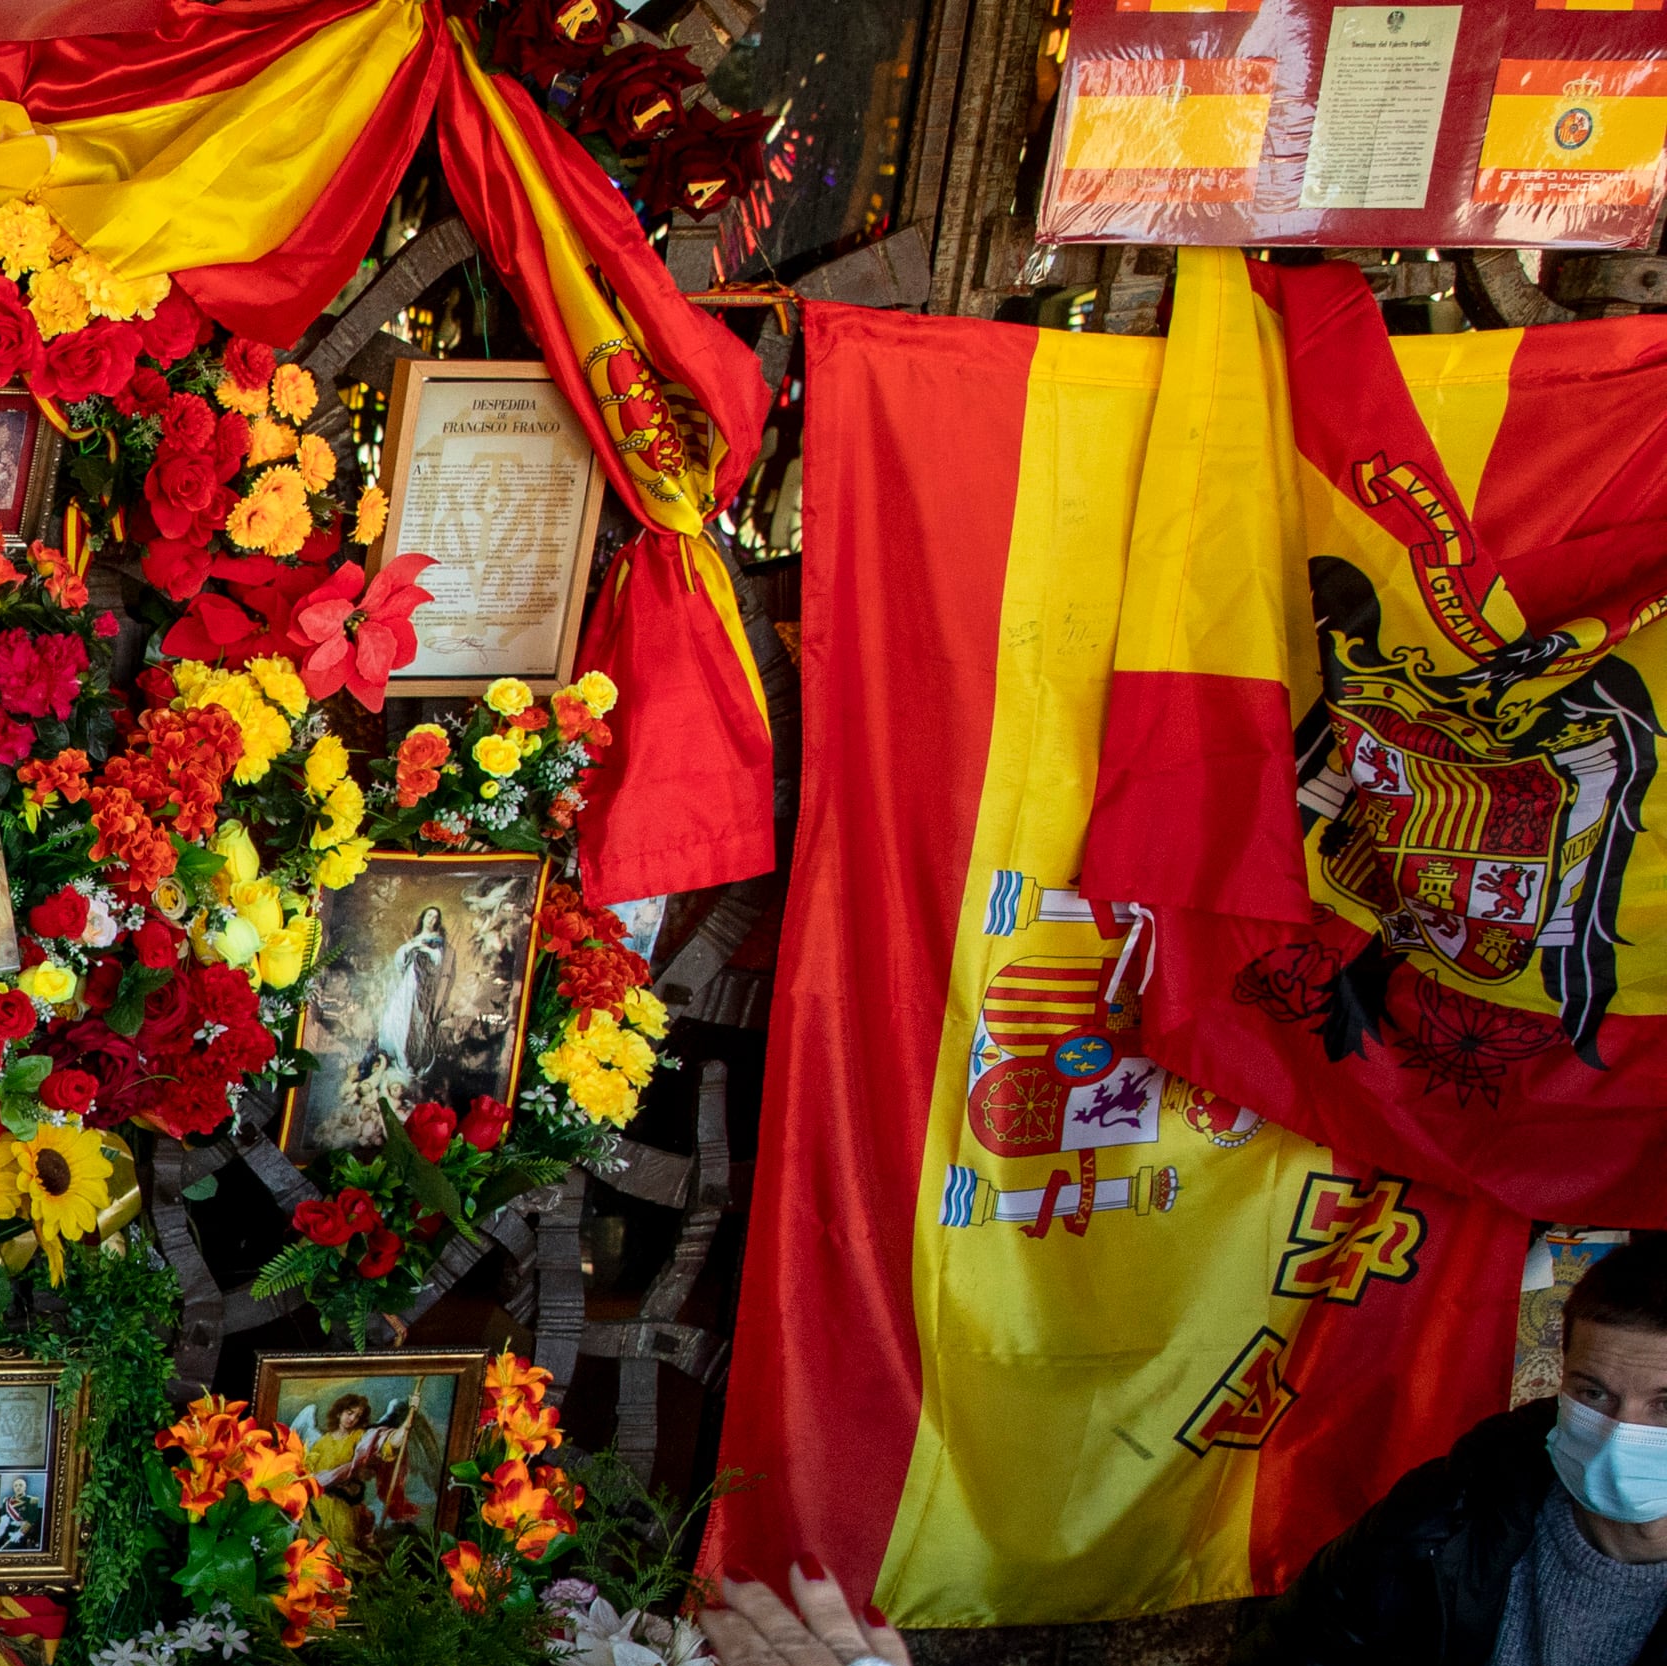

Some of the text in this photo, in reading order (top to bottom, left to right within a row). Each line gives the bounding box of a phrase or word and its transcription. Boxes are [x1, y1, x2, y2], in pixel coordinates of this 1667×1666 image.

[1500, 171, 1628, 181] CUERPO NACIONAL
[1524, 182, 1544, 191] DE
[472, 399, 537, 411] DESPEDIDA
[442, 421, 561, 433] FRANCISCO FRANCO
[1429, 574, 1490, 648] GRAN
